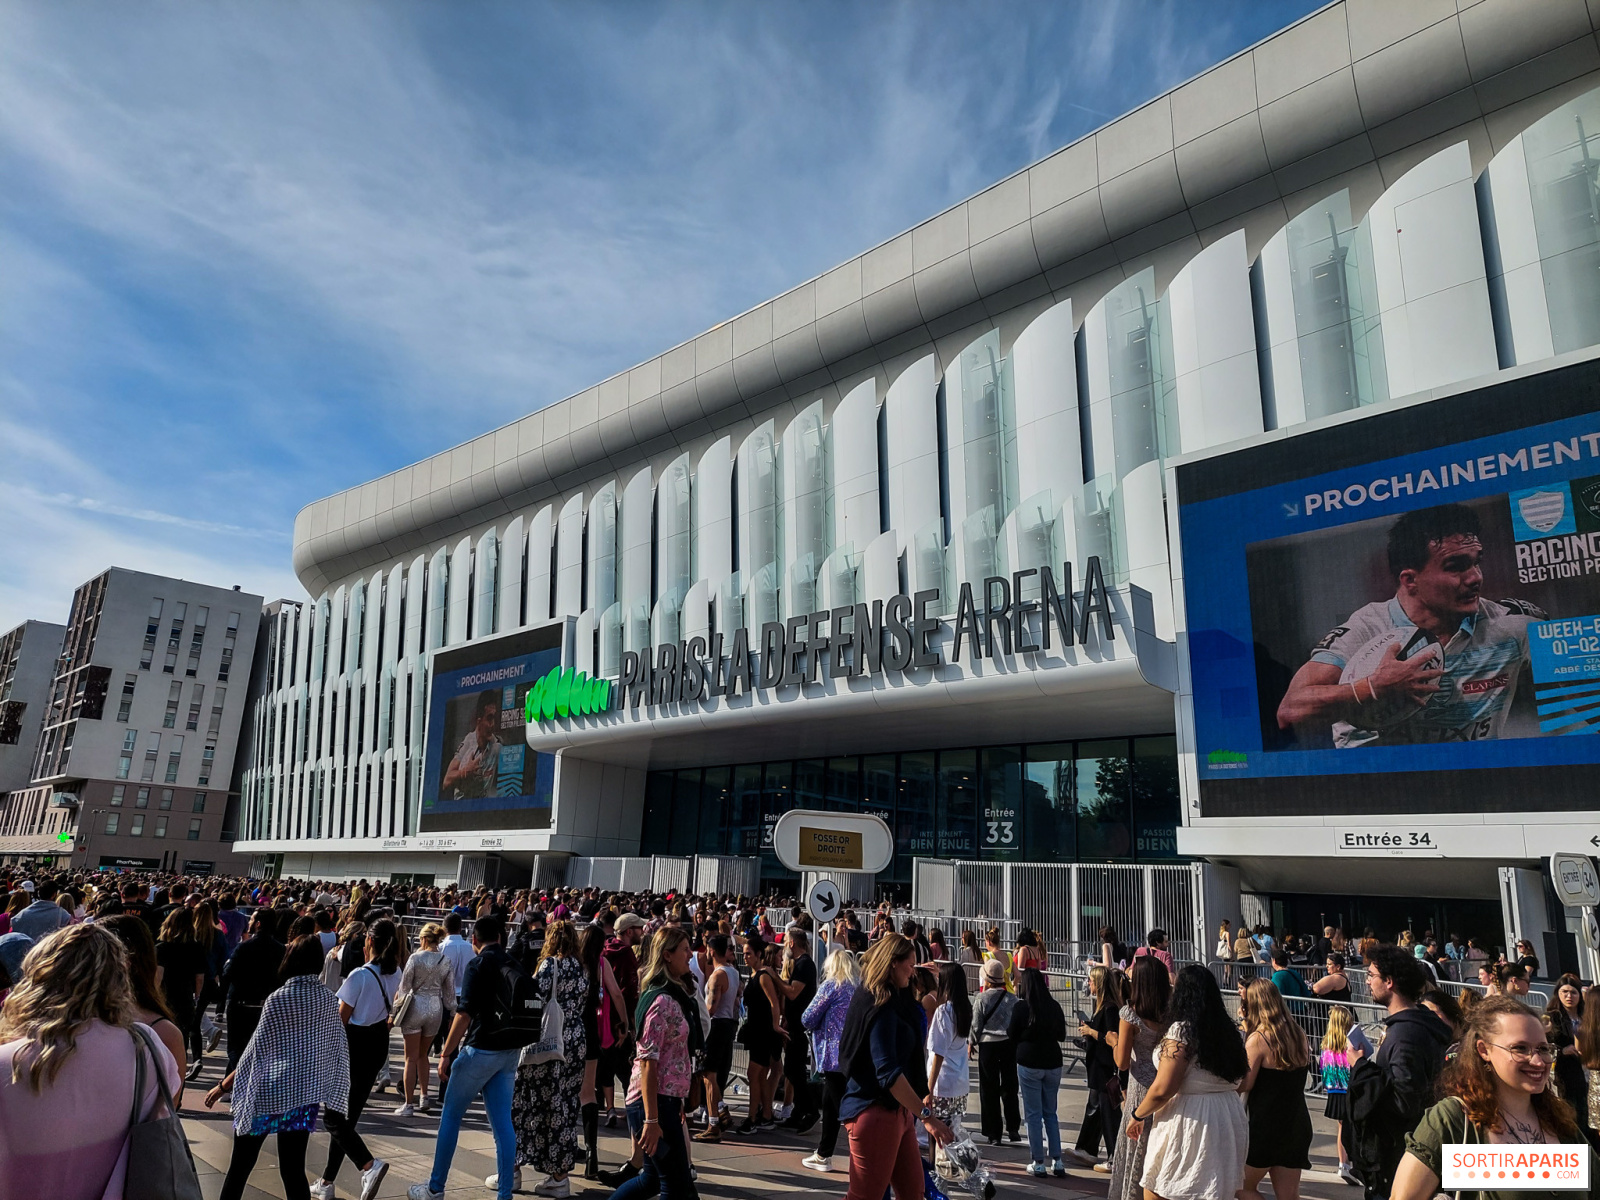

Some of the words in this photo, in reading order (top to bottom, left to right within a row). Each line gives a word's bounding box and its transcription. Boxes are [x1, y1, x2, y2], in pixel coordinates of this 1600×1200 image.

[1305, 432, 1600, 516] PROCHAINEMENT
[1514, 531, 1600, 569] RACING
[1518, 561, 1582, 584] SECTION
[617, 635, 706, 710] PARIS
[709, 626, 752, 697] LA
[758, 588, 940, 690] DEFENSE
[952, 555, 1116, 663] ARENA
[461, 664, 526, 688] PROCHAINEMENT
[984, 808, 1015, 818] Entrée
[481, 838, 495, 846] Entrée
[496, 838, 502, 846] 32
[813, 833, 838, 844] FOSSE
[838, 836, 850, 845] OR
[986, 821, 1014, 844] 33
[1344, 831, 1403, 846] Entrée
[1408, 832, 1432, 846] 34
[817, 844, 846, 855] DROITE
[1562, 868, 1580, 884] ENTRÉE
[1583, 871, 1595, 889] 34
